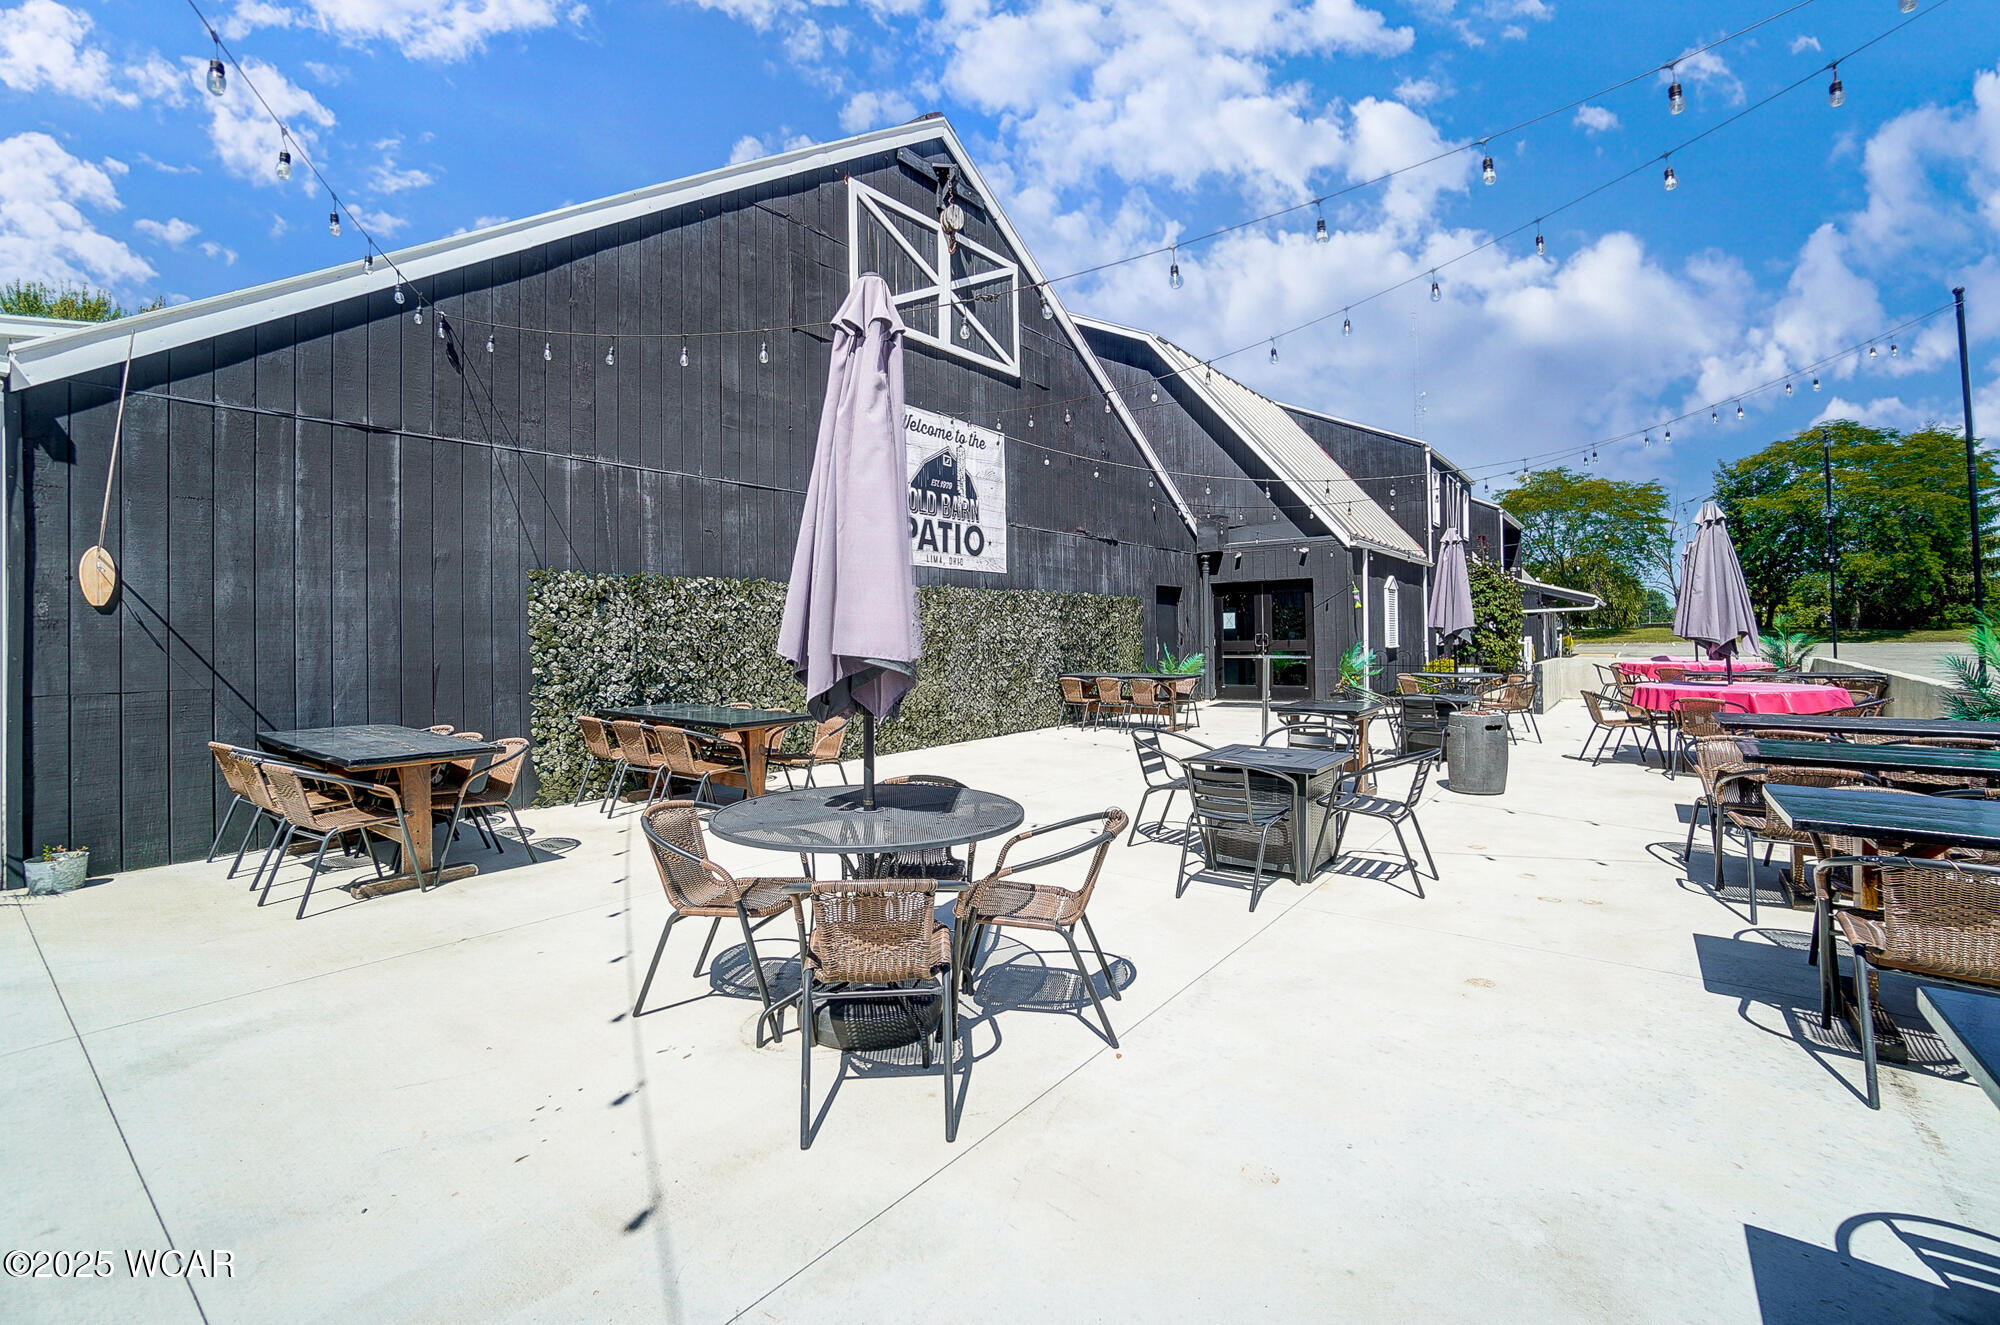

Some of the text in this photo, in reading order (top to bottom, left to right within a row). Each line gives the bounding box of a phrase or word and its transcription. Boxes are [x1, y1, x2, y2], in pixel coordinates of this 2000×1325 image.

[955, 429, 967, 444] to
[969, 433, 987, 450] the
[908, 487, 980, 523] OLD BARN
[949, 556, 964, 566] OHIO
